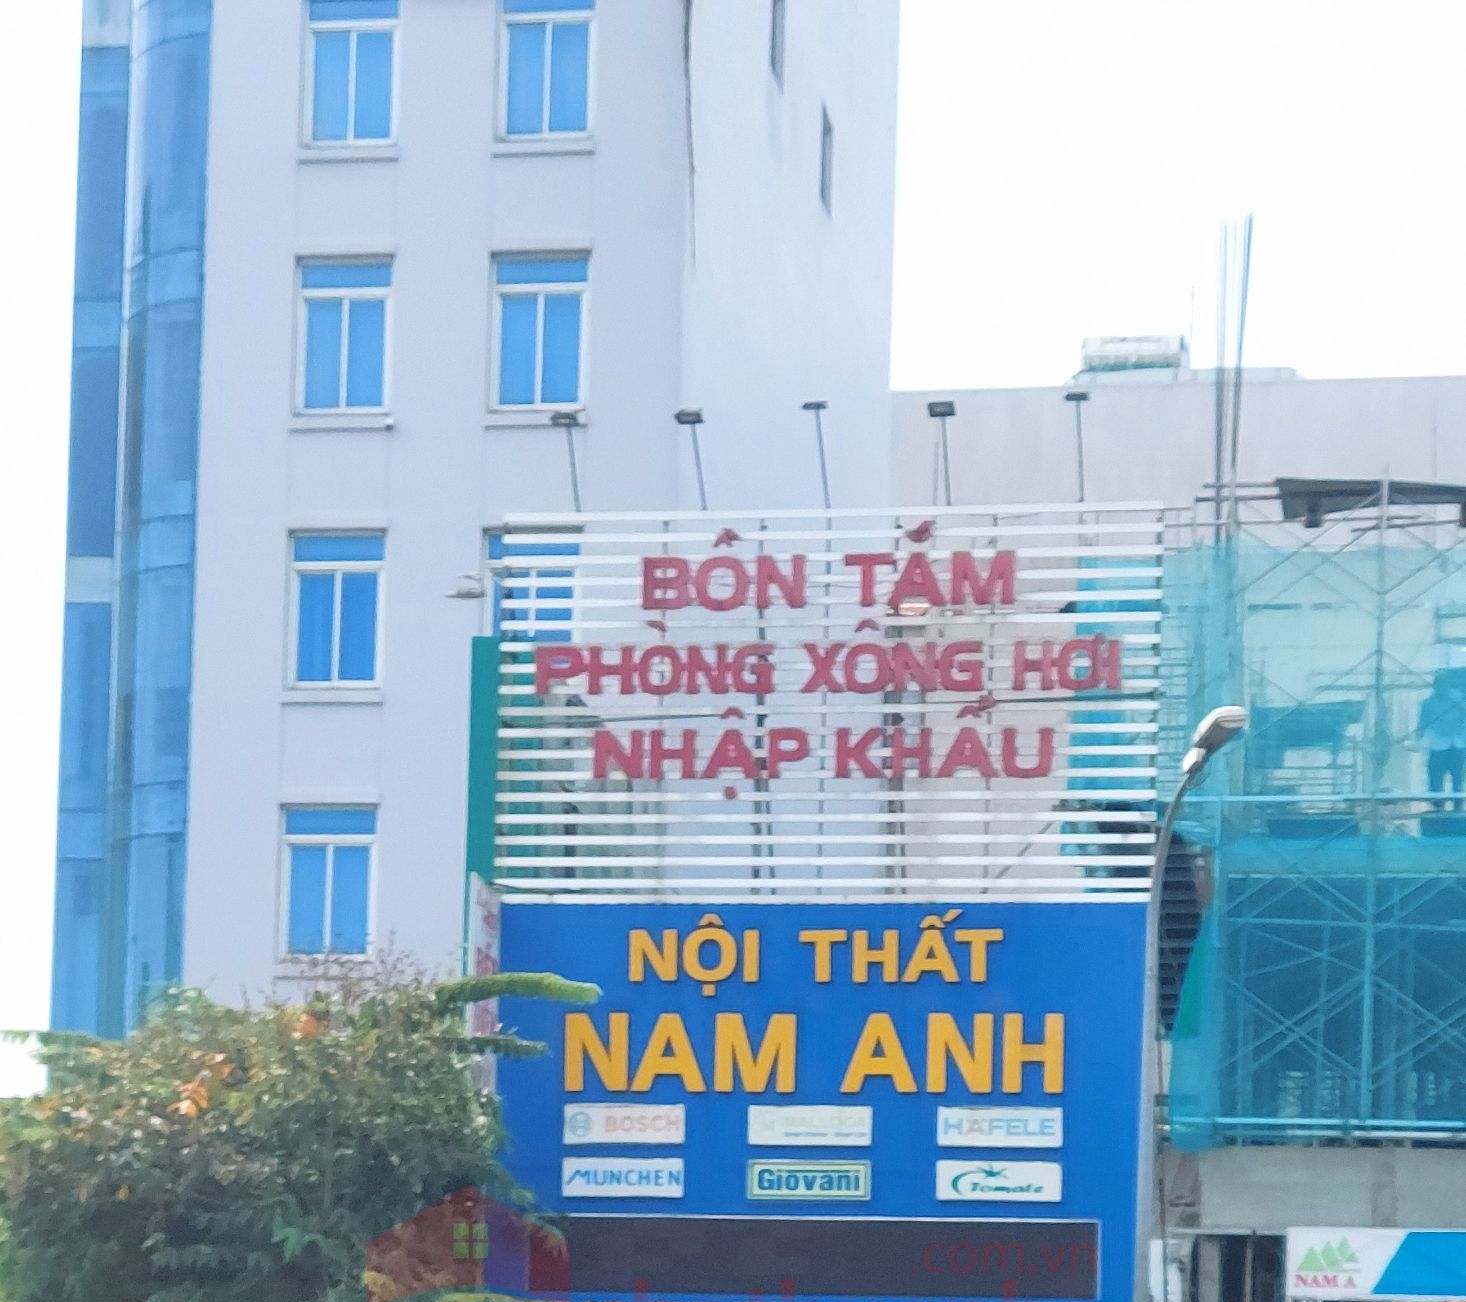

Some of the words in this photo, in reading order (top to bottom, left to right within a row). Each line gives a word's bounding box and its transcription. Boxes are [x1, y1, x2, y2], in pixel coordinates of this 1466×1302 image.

[535, 620, 776, 695] PHÒNG
[801, 619, 984, 693] XÔNG
[1012, 633, 1122, 691] HƠI
[592, 707, 810, 800] NHẬP
[835, 694, 1055, 778] KHẨU
[628, 914, 760, 996] NỘI
[799, 909, 1004, 983] THẤT
[563, 1012, 797, 1093] NAM
[839, 1012, 1065, 1094] ANH
[604, 1114, 682, 1133] BOSCH
[757, 1168, 861, 1193] Giovani
[1295, 1274, 1339, 1289] NAM
